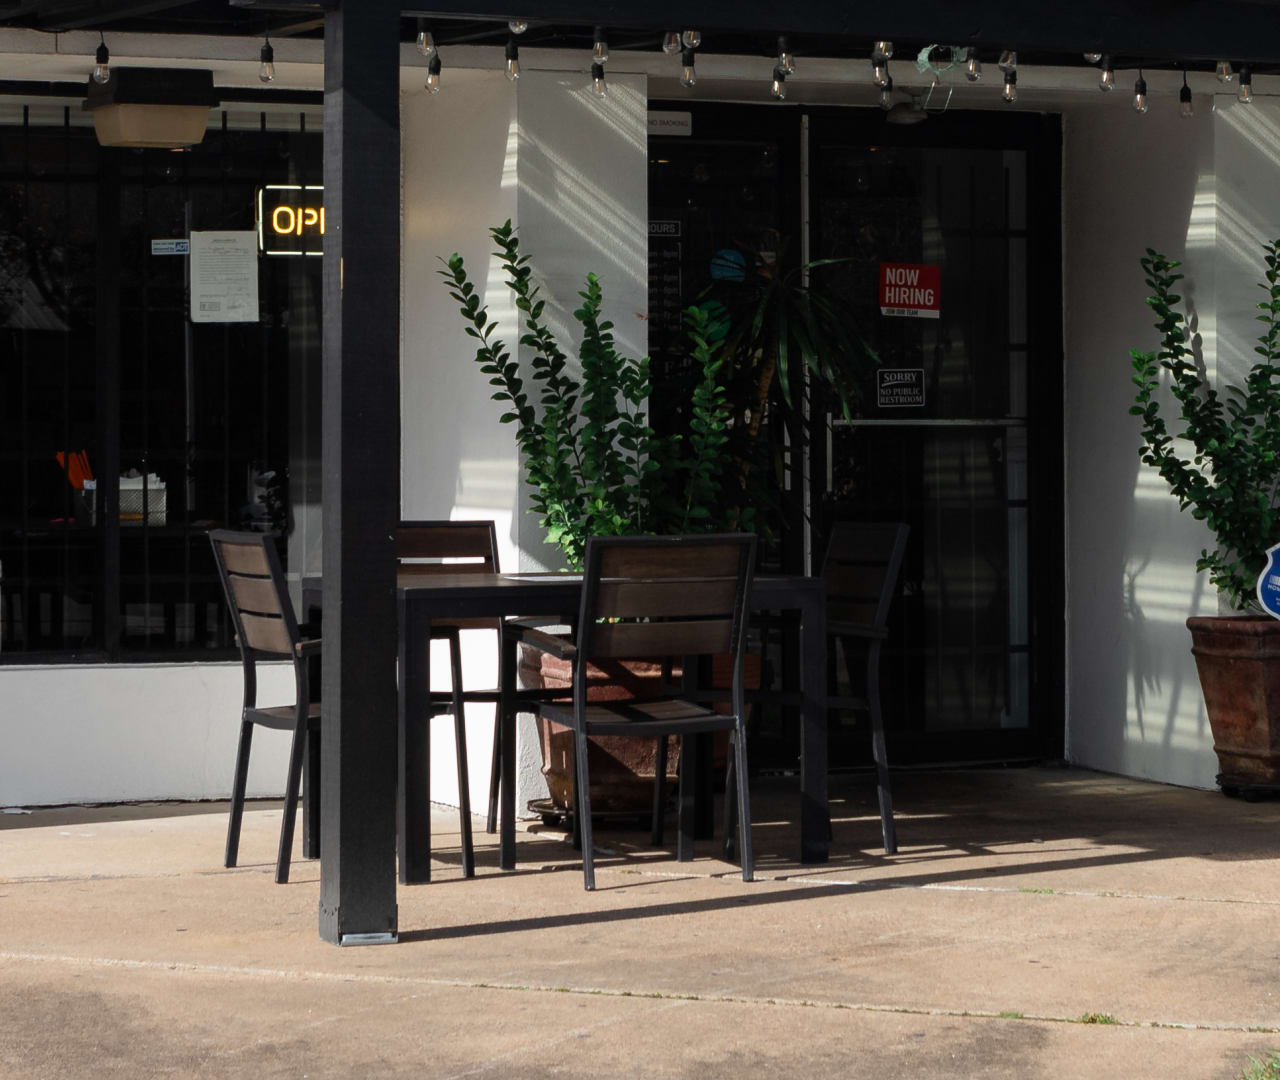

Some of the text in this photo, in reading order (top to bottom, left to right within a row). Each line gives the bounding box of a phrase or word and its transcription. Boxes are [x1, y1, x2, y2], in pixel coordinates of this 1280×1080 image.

[885, 267, 919, 286] NOW
[885, 286, 934, 306] HIRING
[884, 372, 917, 383] SORRY
[880, 387, 921, 396] NO PUBLIC
[880, 395, 923, 404] RESTROOM
